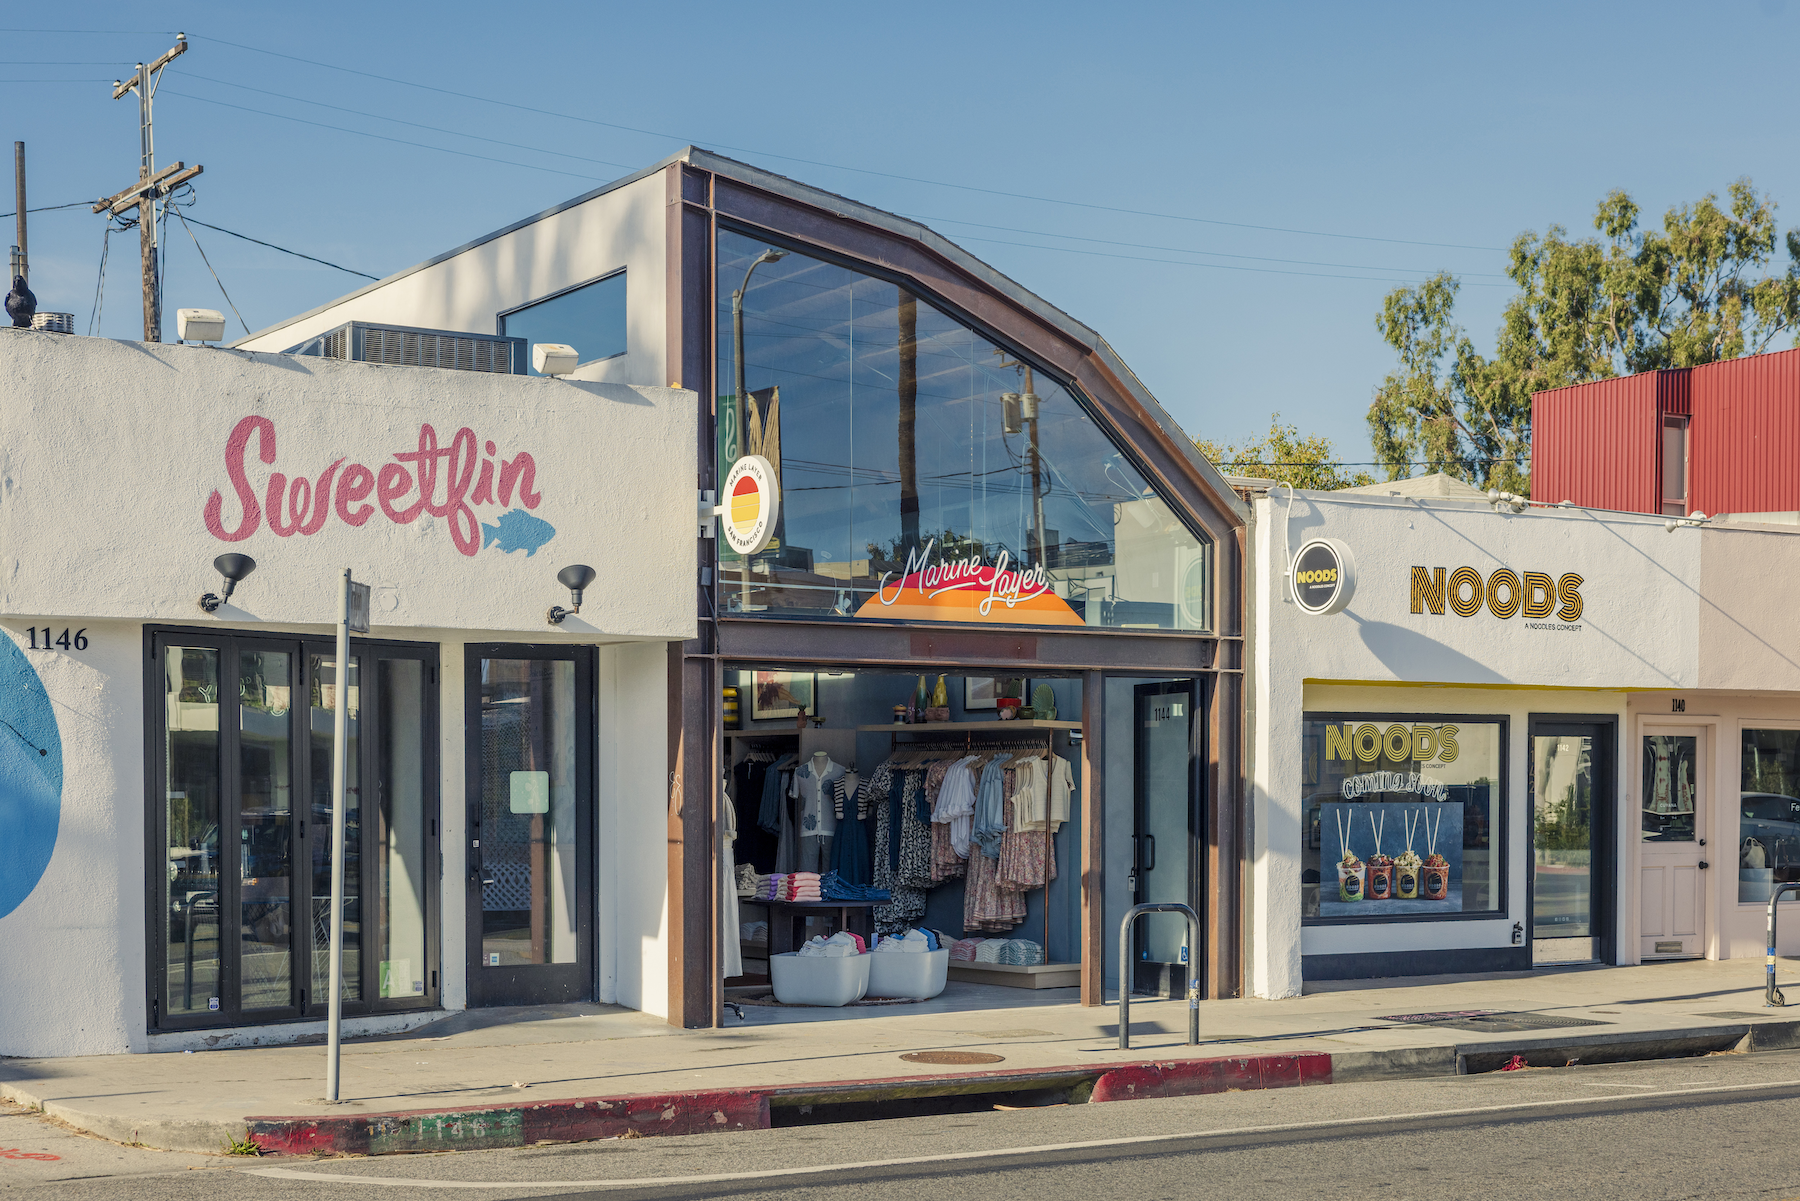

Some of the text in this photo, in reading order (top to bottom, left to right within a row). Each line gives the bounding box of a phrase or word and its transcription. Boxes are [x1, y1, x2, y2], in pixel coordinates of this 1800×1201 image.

[203, 415, 541, 557] Sweetfin
[729, 463, 762, 487] MARINE LAYER
[727, 521, 763, 547] SAN FRANCISCO
[879, 538, 1049, 616] Marine Layer
[1297, 568, 1337, 584] NOODS
[1410, 566, 1584, 622] NOODS
[26, 626, 89, 651] 1146
[1530, 623, 1556, 631] NOODLES
[1557, 624, 1582, 632] CONCEPT
[1154, 706, 1171, 721] 1144
[1671, 698, 1686, 713] 1140
[1325, 724, 1460, 763] NOODS
[1556, 744, 1570, 752] 1142
[383, 969, 396, 989] A
